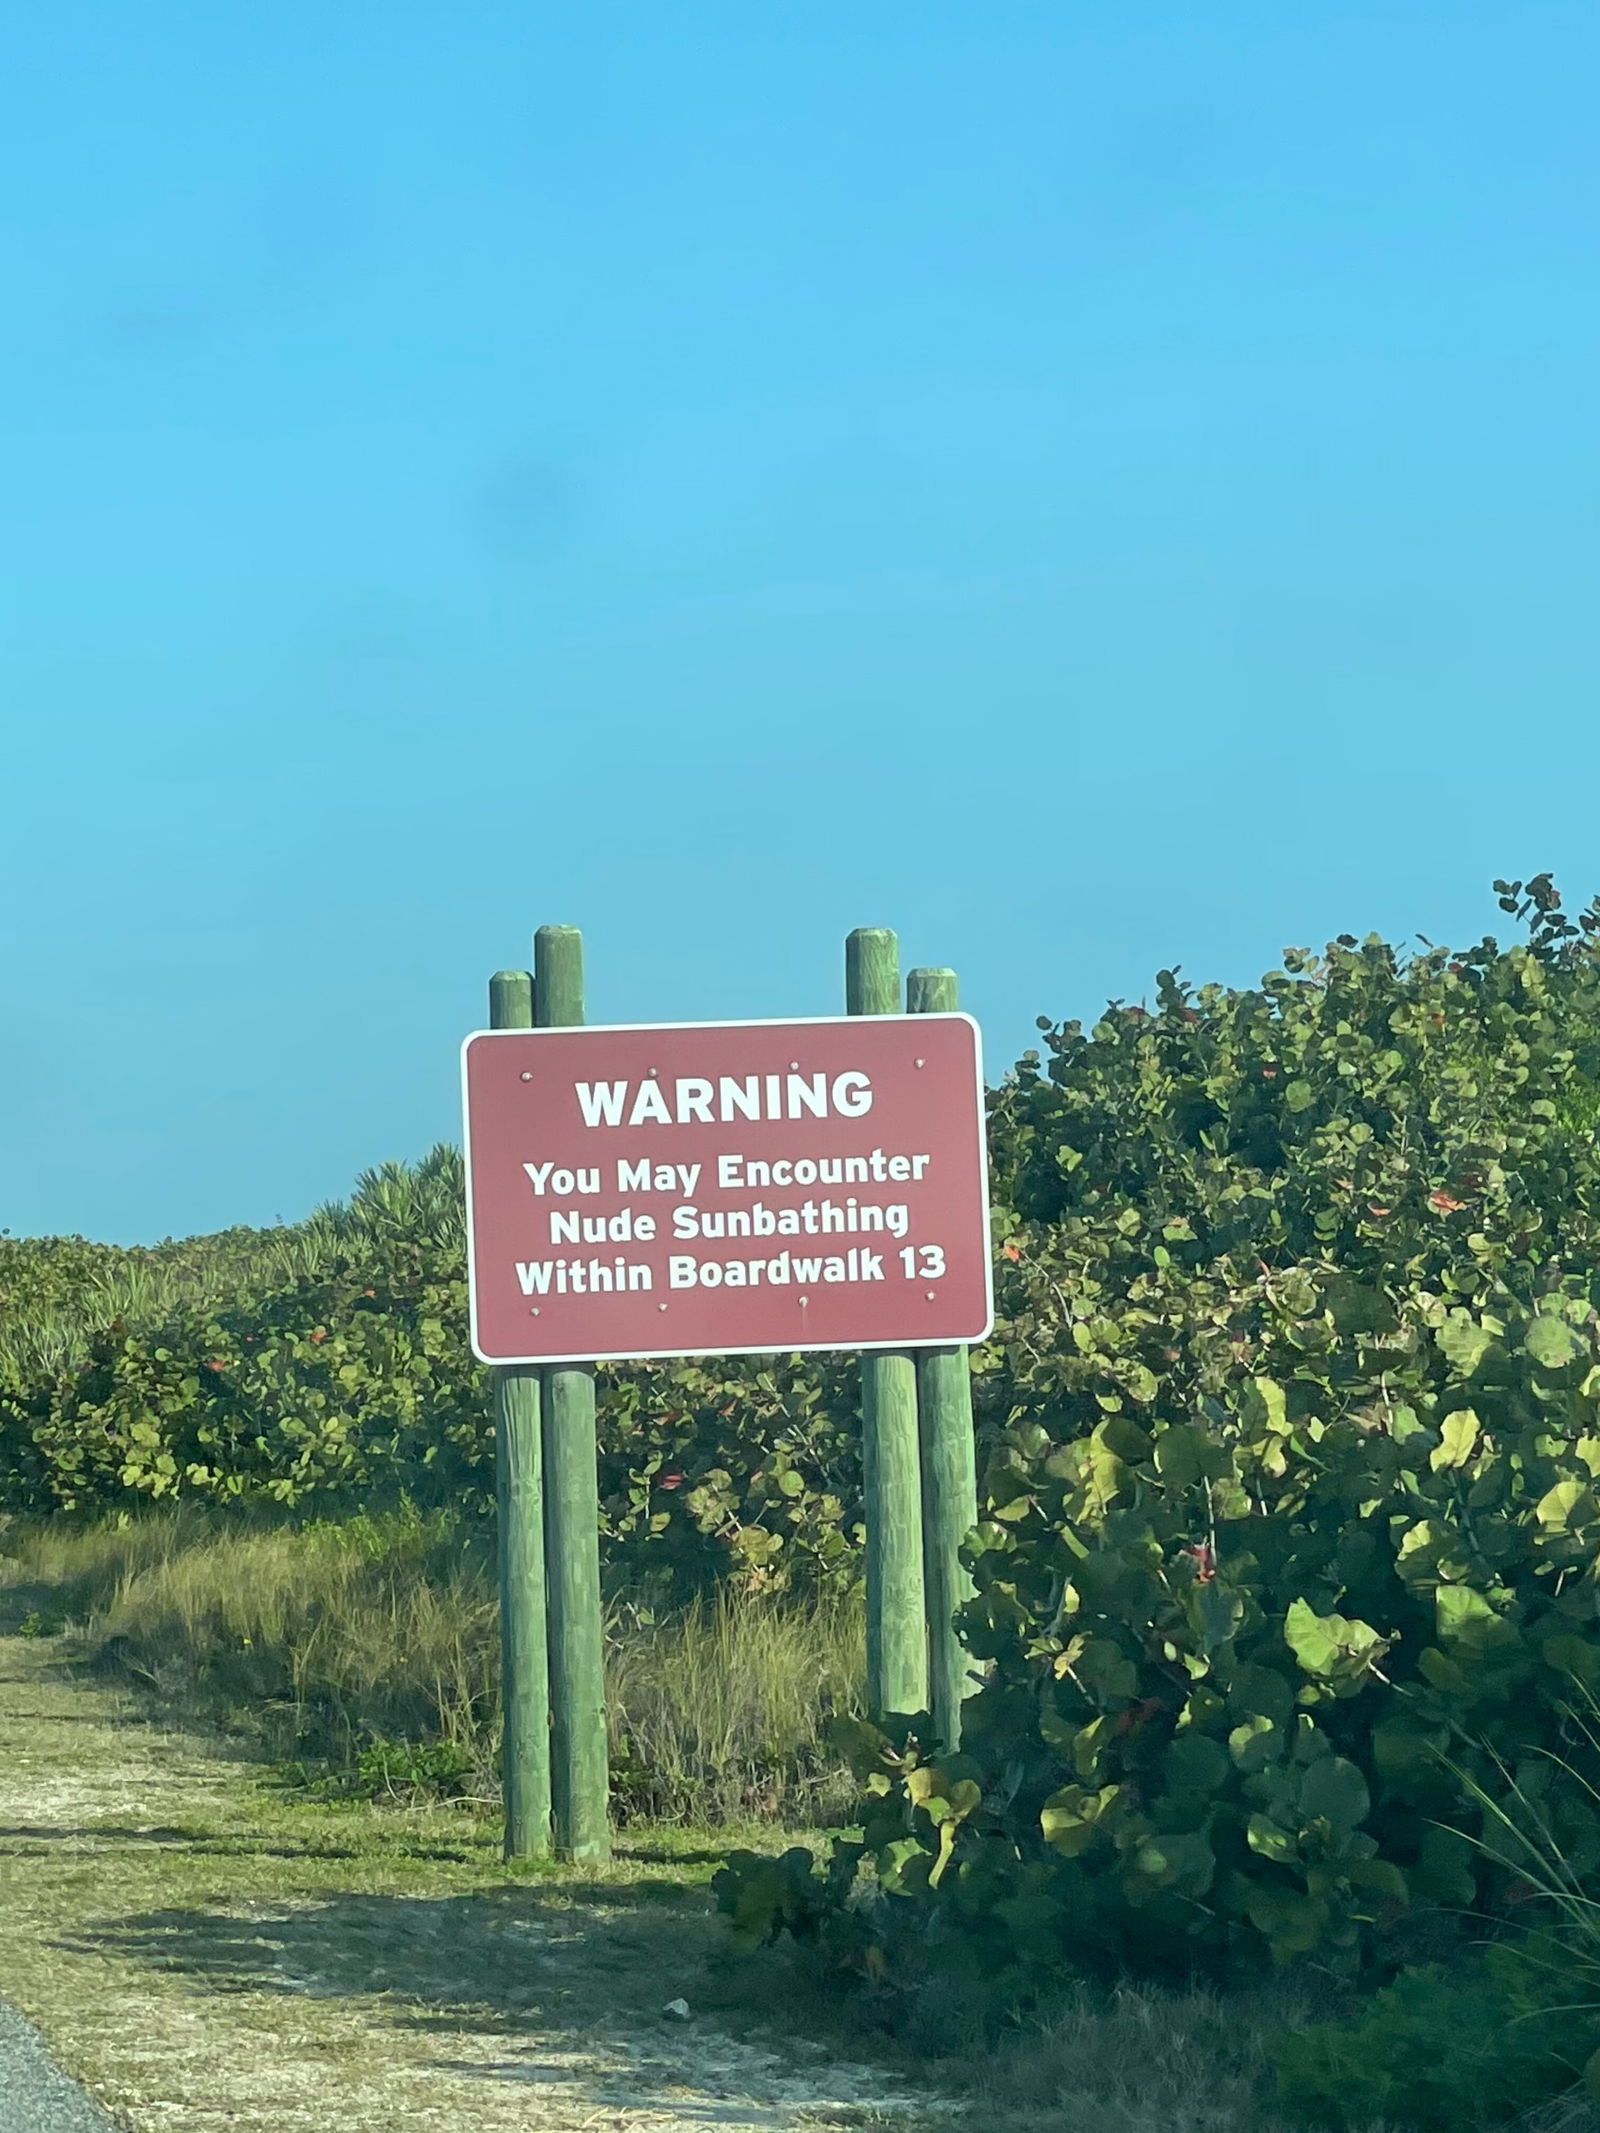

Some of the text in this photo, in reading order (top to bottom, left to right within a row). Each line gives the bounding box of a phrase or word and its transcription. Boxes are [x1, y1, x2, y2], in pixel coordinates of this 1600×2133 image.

[574, 1071, 873, 1128] WARNING
[523, 1148, 931, 1198] You May Encounter
[550, 1197, 909, 1245] Nude Sunbathing
[515, 1244, 946, 1296] Within Boardwalk 13
